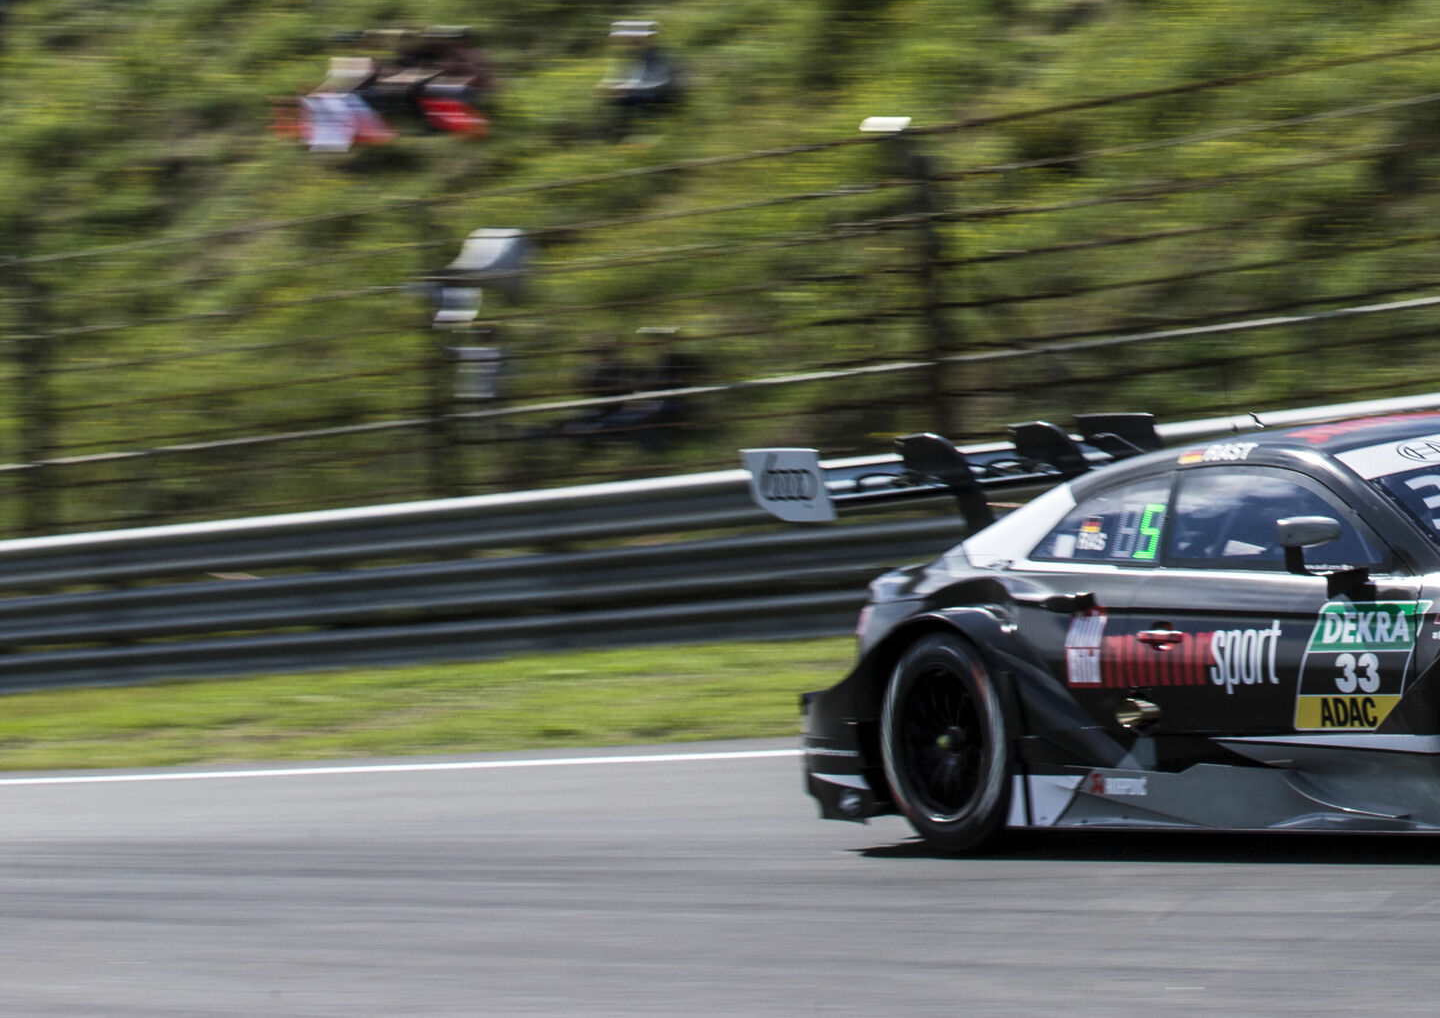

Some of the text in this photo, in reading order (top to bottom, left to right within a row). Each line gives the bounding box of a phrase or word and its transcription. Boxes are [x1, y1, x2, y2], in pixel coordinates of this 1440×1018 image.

[1203, 443, 1260, 462] RAST
[1322, 610, 1410, 644] DEKRA
[1334, 652, 1381, 693] 33
[1321, 697, 1378, 728] ADAC
